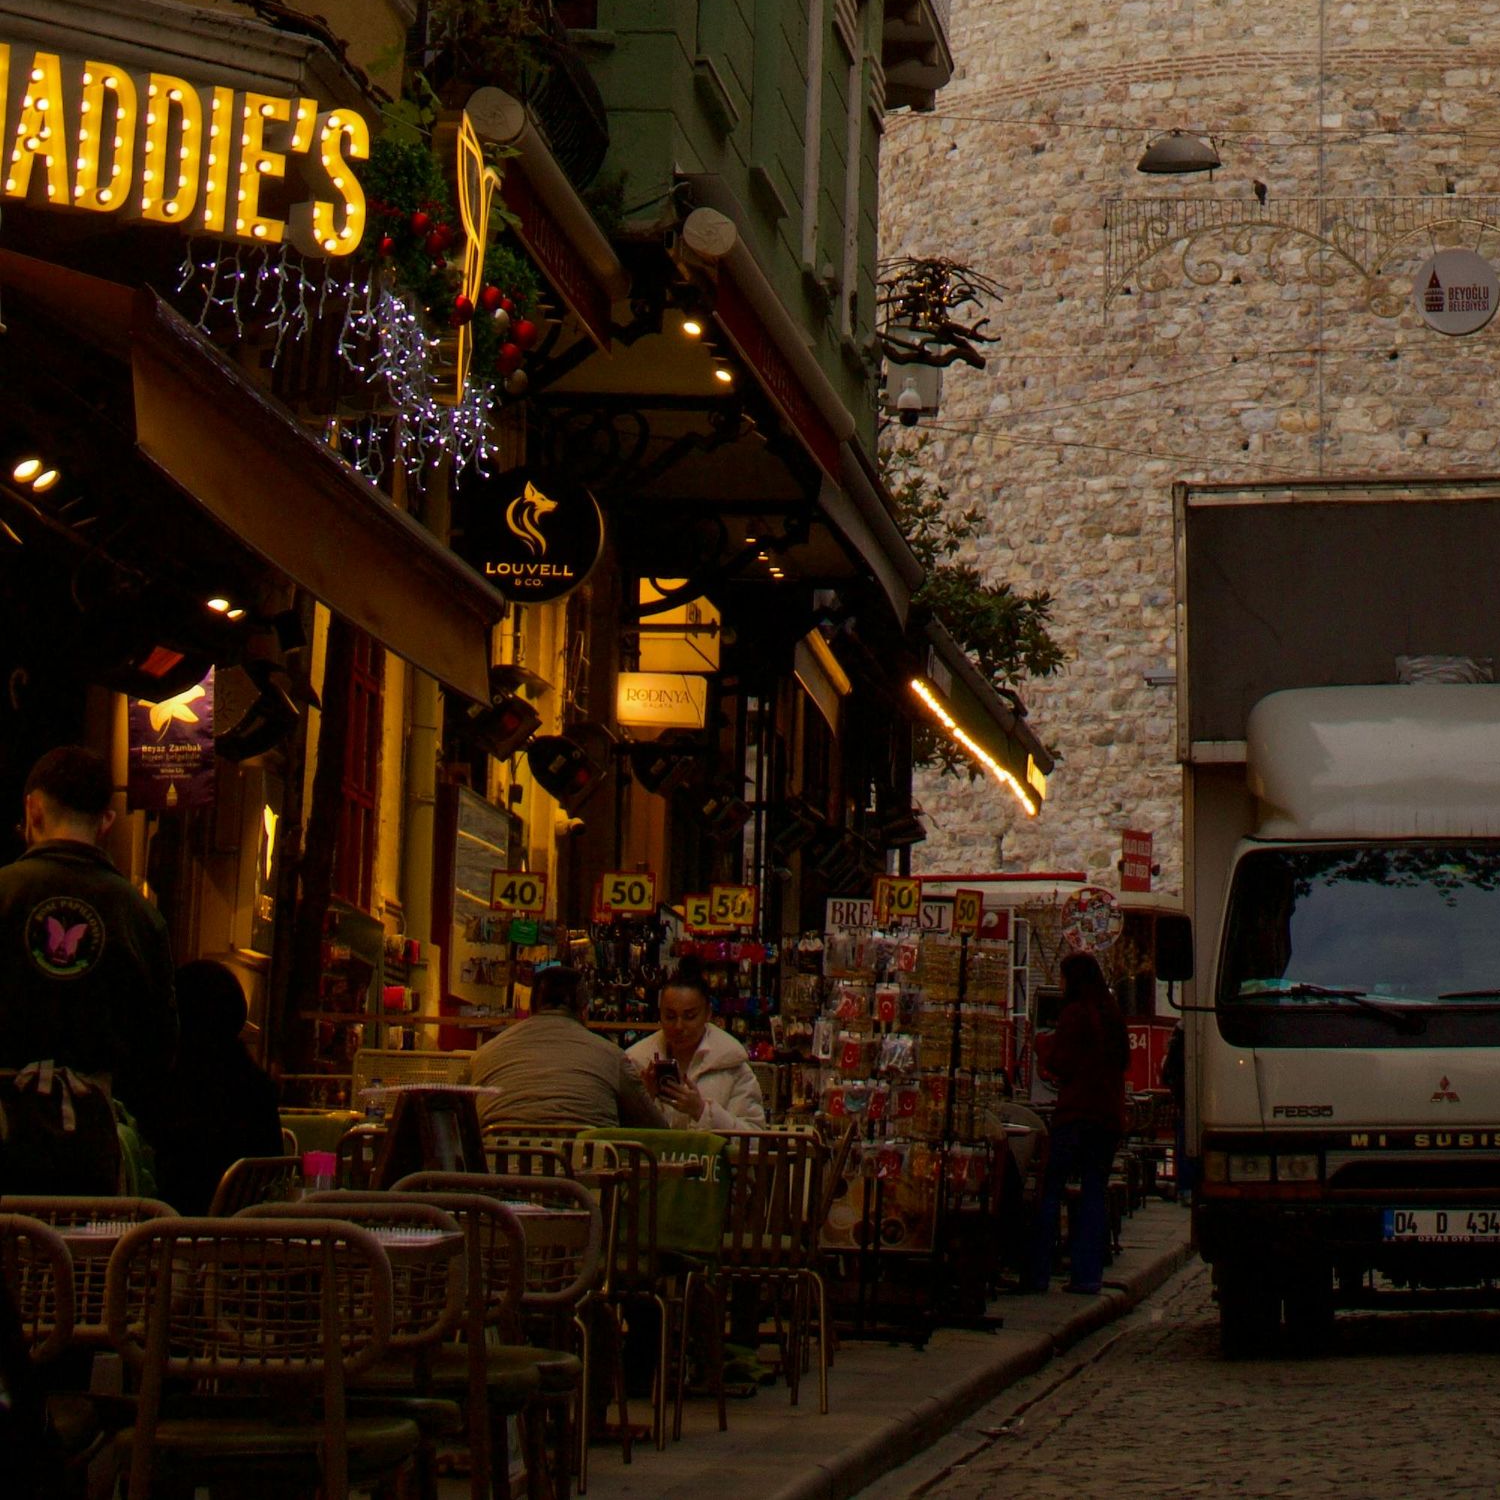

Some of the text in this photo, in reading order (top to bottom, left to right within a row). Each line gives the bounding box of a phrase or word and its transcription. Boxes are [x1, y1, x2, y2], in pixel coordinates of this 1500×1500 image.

[0, 43, 370, 257] ADDIE'S
[1448, 283, 1489, 301] BEYOĞLU
[1448, 300, 1490, 313] BELEDİYESİ
[485, 561, 574, 577] LOUVELL
[523, 578, 544, 587] CO.
[626, 687, 690, 703] RODINYA
[168, 743, 202, 752] Zambak
[692, 904, 707, 926] 5
[1395, 1212, 1418, 1234] 04
[1436, 1212, 1447, 1234] D
